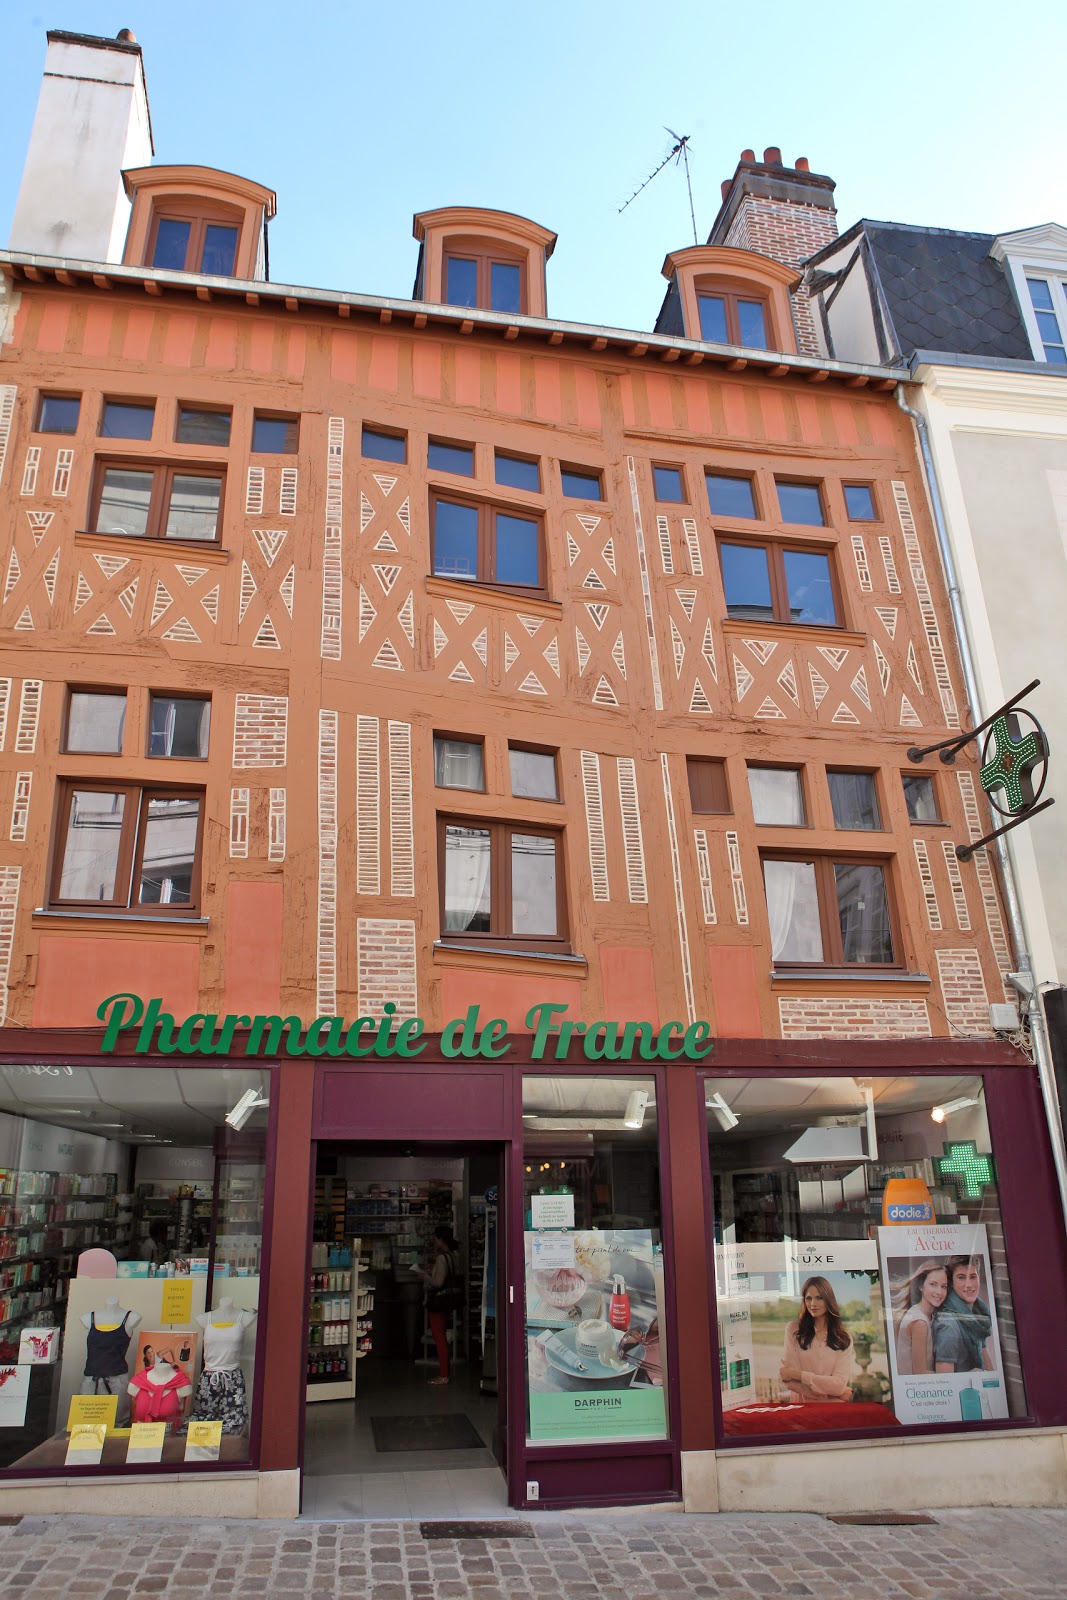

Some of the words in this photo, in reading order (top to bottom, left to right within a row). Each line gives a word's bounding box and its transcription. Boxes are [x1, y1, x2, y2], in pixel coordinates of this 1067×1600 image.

[97, 993, 428, 1057] Pharmacie
[440, 1005, 511, 1058] de
[525, 1003, 714, 1060] France
[890, 1206, 922, 1219] dodie
[914, 1236, 955, 1251] Avène
[790, 1255, 834, 1264] NUXE
[905, 1387, 953, 1399] Cleanance
[574, 1398, 622, 1407] DARPHIN
